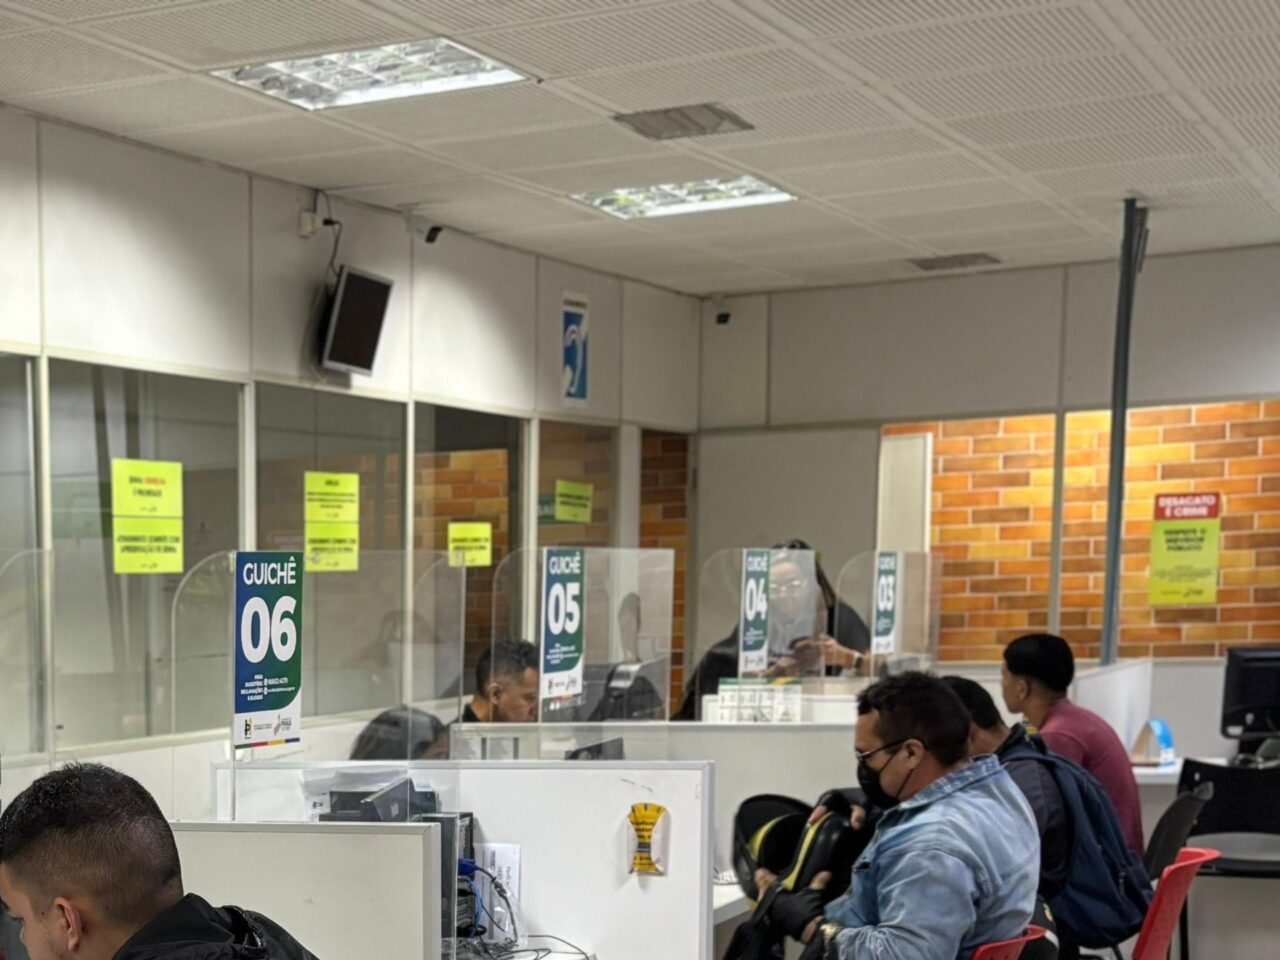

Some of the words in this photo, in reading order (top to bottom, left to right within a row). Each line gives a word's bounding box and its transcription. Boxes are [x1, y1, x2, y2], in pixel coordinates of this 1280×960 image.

[243, 555, 297, 585] GUICHÊ
[548, 582, 581, 635] 05
[745, 577, 768, 621] 04
[241, 595, 297, 664] 06
